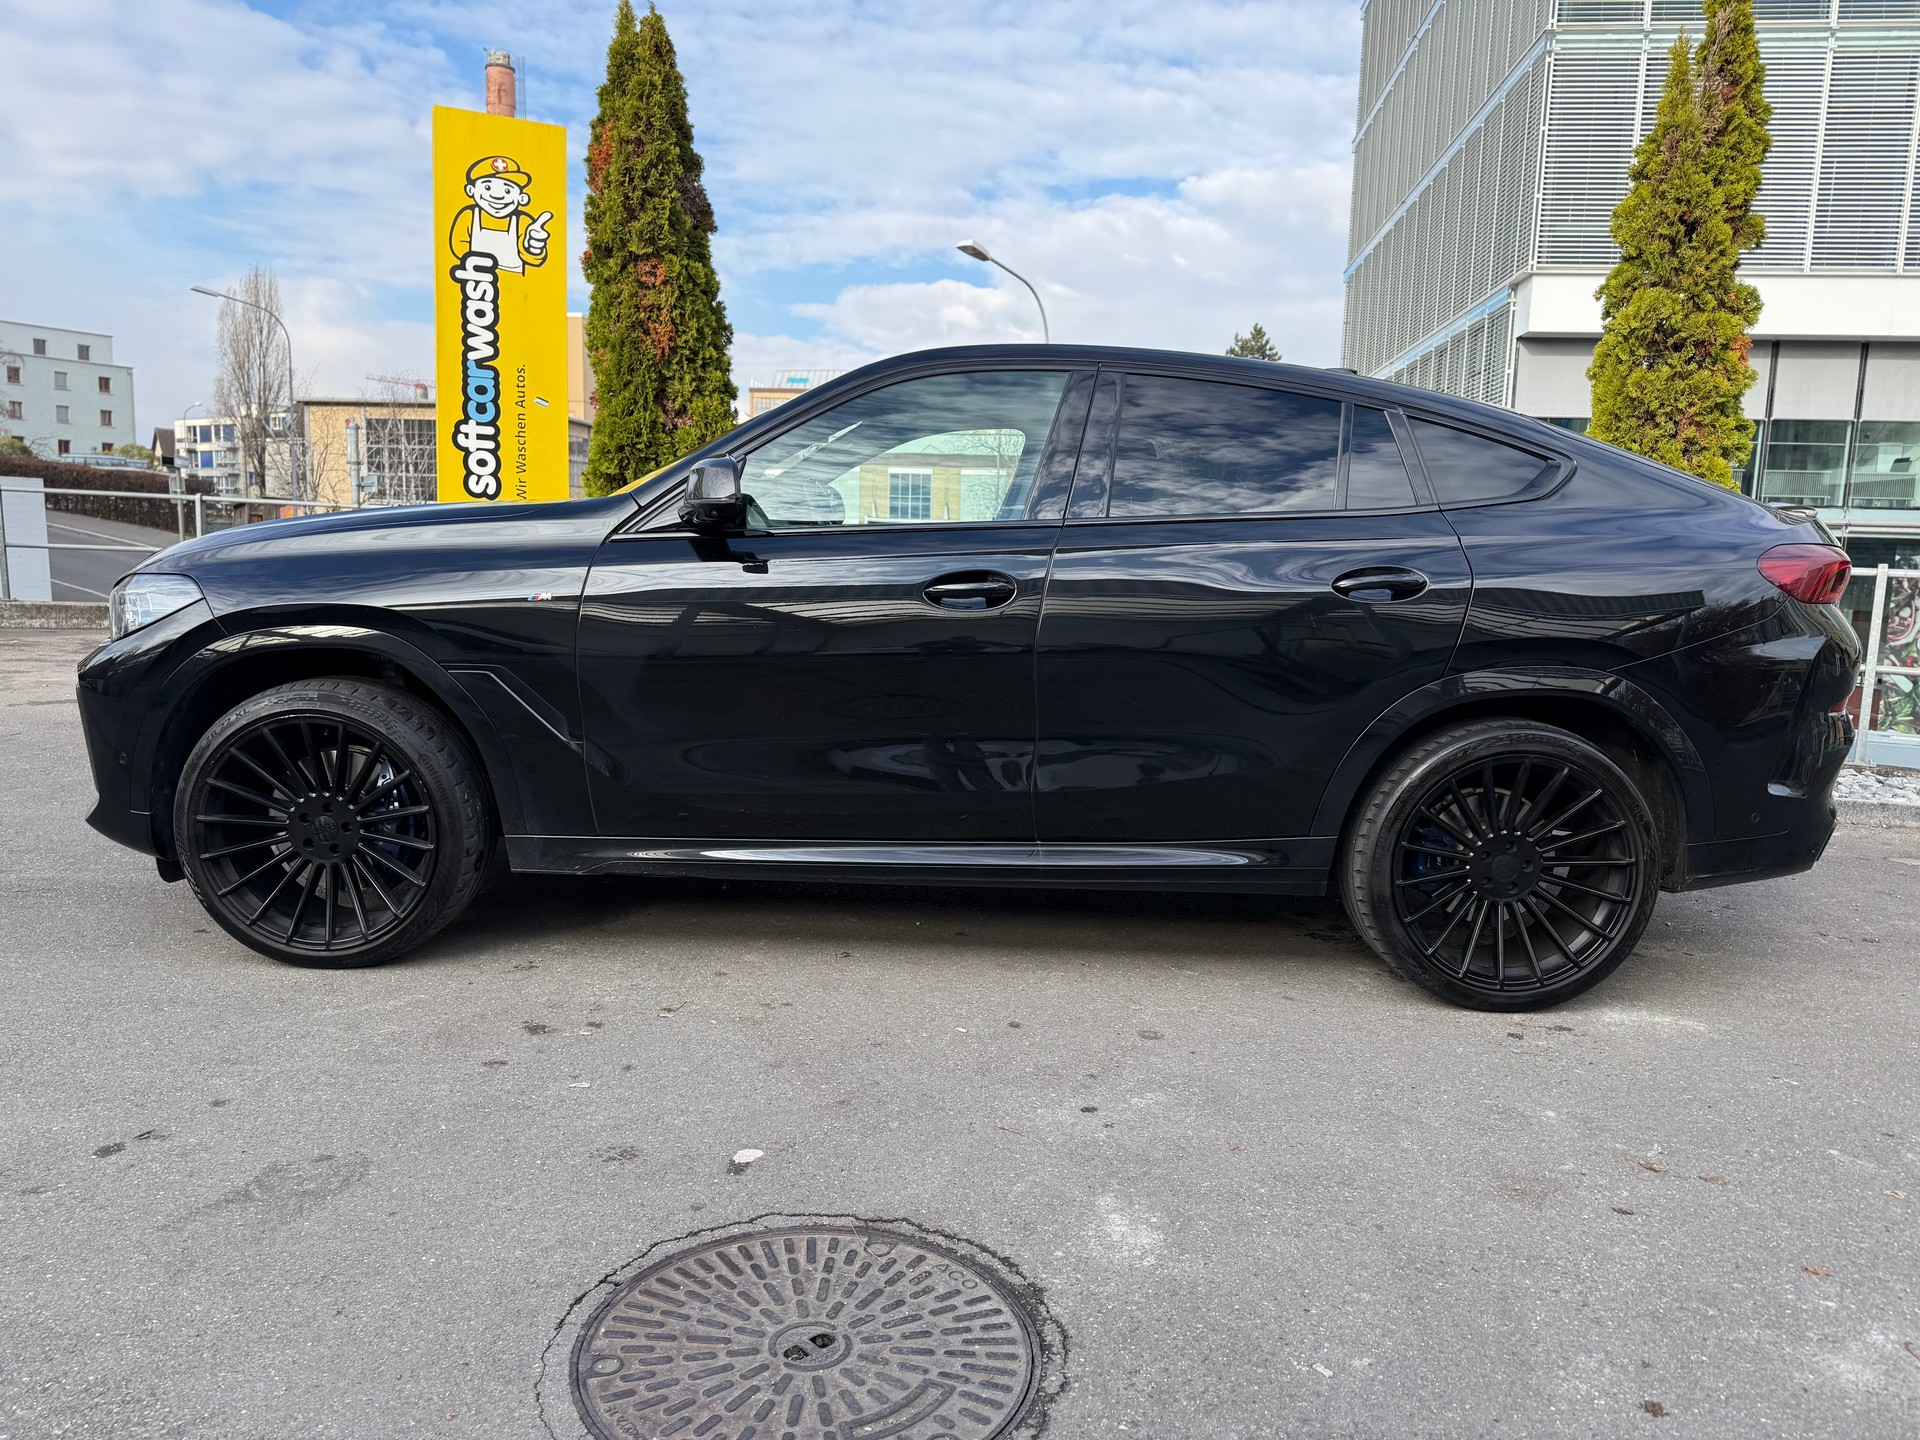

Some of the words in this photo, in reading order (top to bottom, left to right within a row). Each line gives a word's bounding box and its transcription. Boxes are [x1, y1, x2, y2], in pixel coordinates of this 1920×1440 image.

[452, 252, 498, 498] softcarwash
[515, 364, 527, 409] Autos.
[514, 413, 527, 474] Waschen
[930, 1263, 979, 1290] ACO
